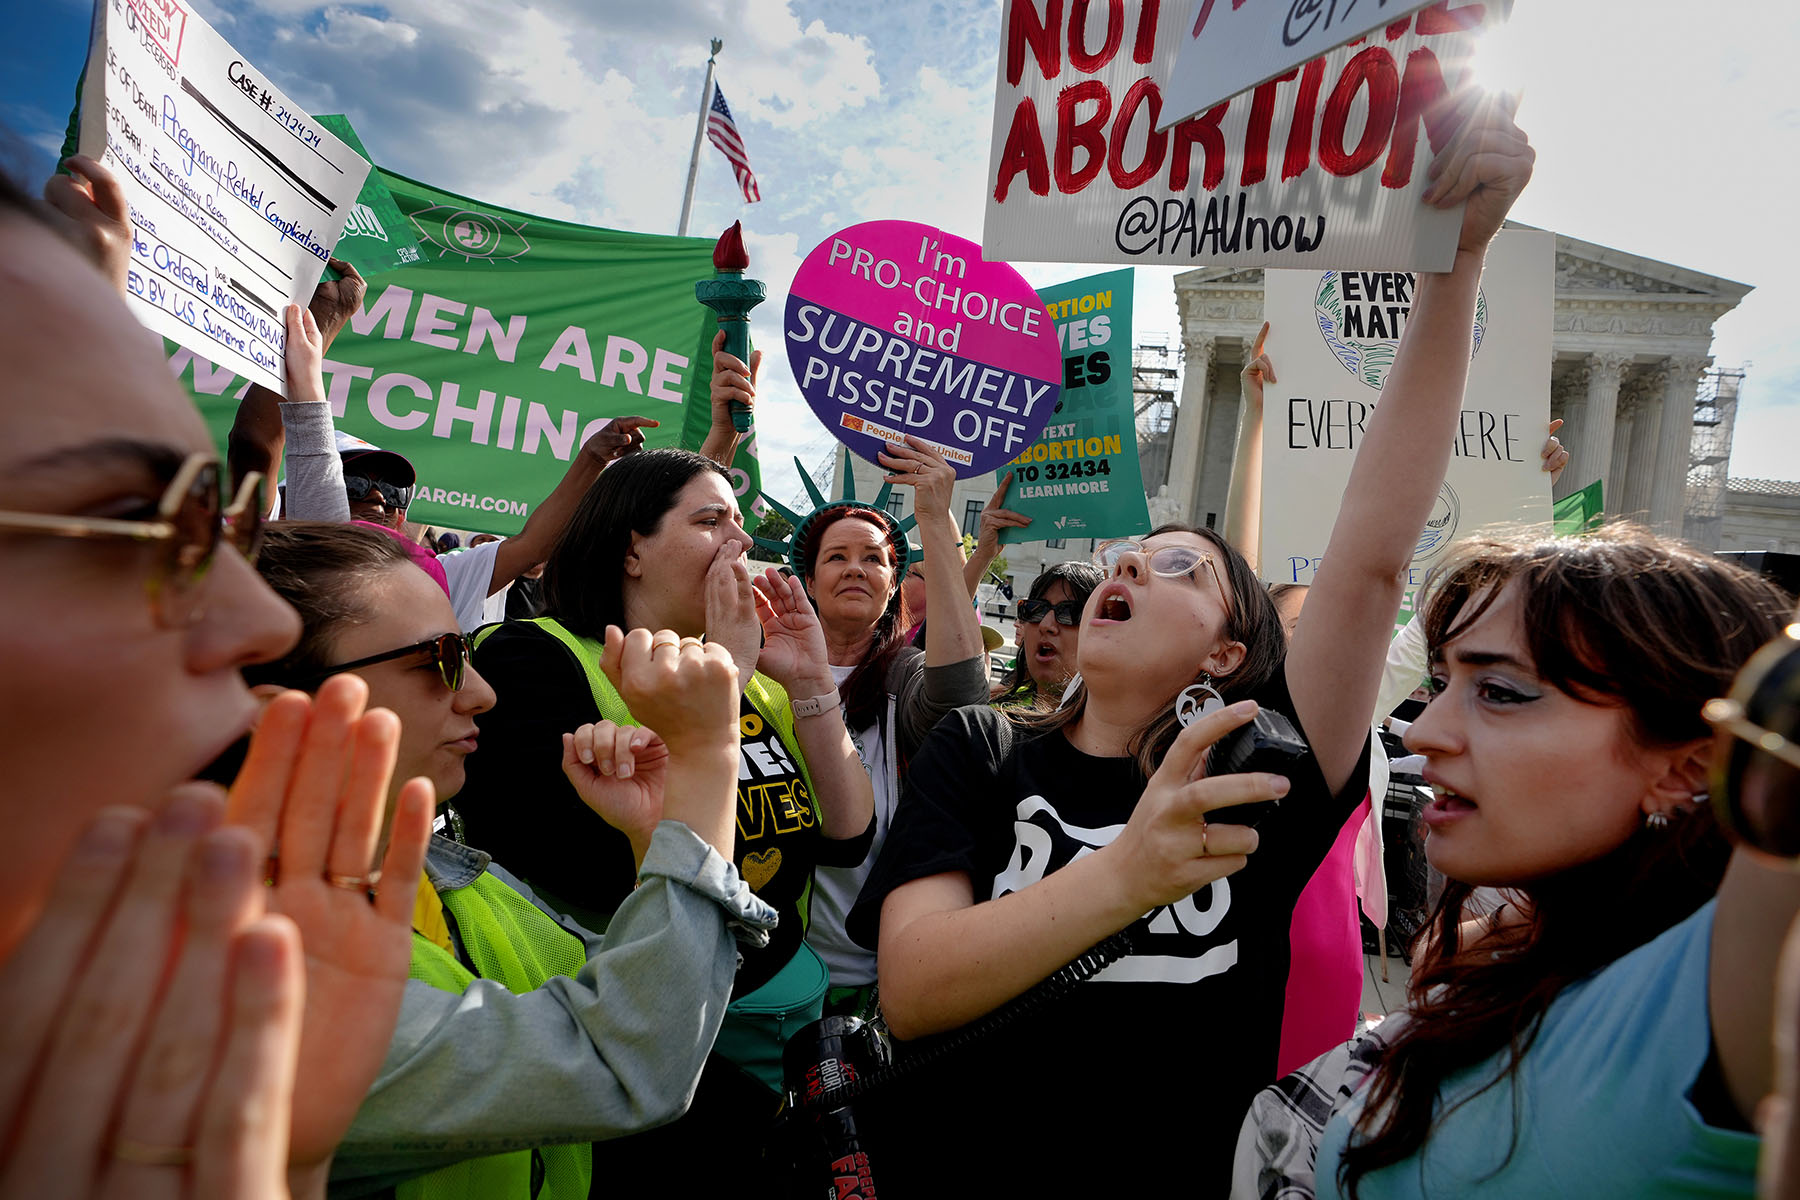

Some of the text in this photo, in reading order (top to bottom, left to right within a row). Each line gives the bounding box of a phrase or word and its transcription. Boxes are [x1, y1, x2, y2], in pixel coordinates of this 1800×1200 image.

[228, 61, 259, 99] CASE
[994, 45, 1456, 203] ABORTION
[153, 147, 202, 214] Emergency
[206, 193, 228, 226] Room
[264, 202, 331, 260] Complications
[918, 236, 967, 279] I'm
[132, 229, 150, 257] te
[153, 245, 208, 295] Ordered
[828, 238, 1042, 338] PRO-CHOICE
[149, 278, 166, 306] BY
[203, 309, 245, 352] Supreme
[249, 339, 276, 370] Court
[893, 310, 962, 353] and
[539, 325, 690, 404] ARE
[787, 305, 1051, 417] SUPREMELY
[802, 356, 935, 428] PISSED
[953, 409, 1026, 454] OFF
[1043, 423, 1076, 439] TEXT
[866, 423, 902, 443] People
[937, 444, 972, 463] United
[1017, 459, 1111, 483] TO 32434
[412, 486, 528, 517] ARCH.COM
[1020, 480, 1110, 499] LEARN MORE
